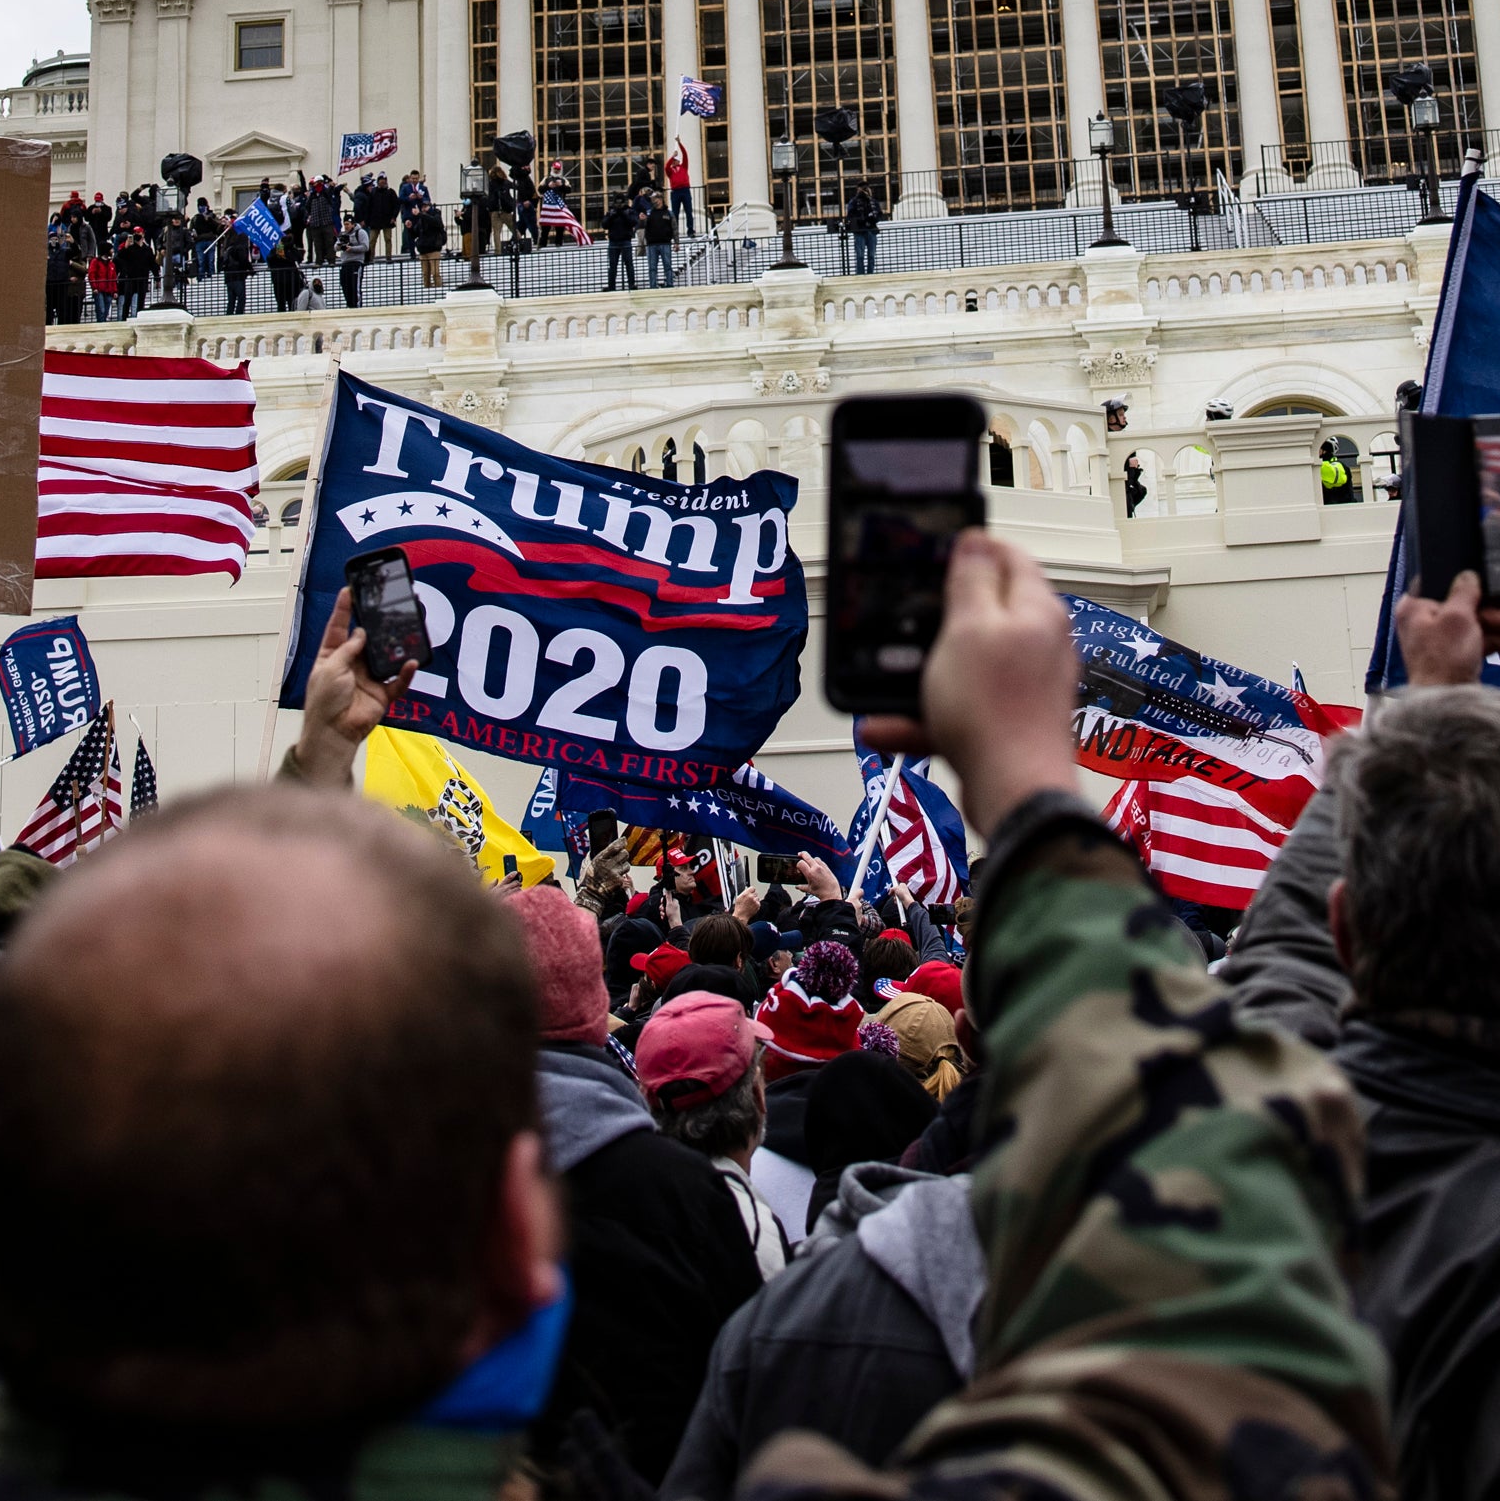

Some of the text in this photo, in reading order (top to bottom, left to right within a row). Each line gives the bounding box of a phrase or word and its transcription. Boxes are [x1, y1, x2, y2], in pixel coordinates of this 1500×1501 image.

[355, 392, 787, 605] Trump
[1090, 620, 1155, 643] Right
[409, 580, 708, 752] 2020
[440, 714, 611, 771] AMERICA
[1140, 731, 1222, 777] TAKE
[1221, 768, 1269, 792] IT
[716, 788, 776, 817] GREAT
[1130, 798, 1148, 827] EEP
